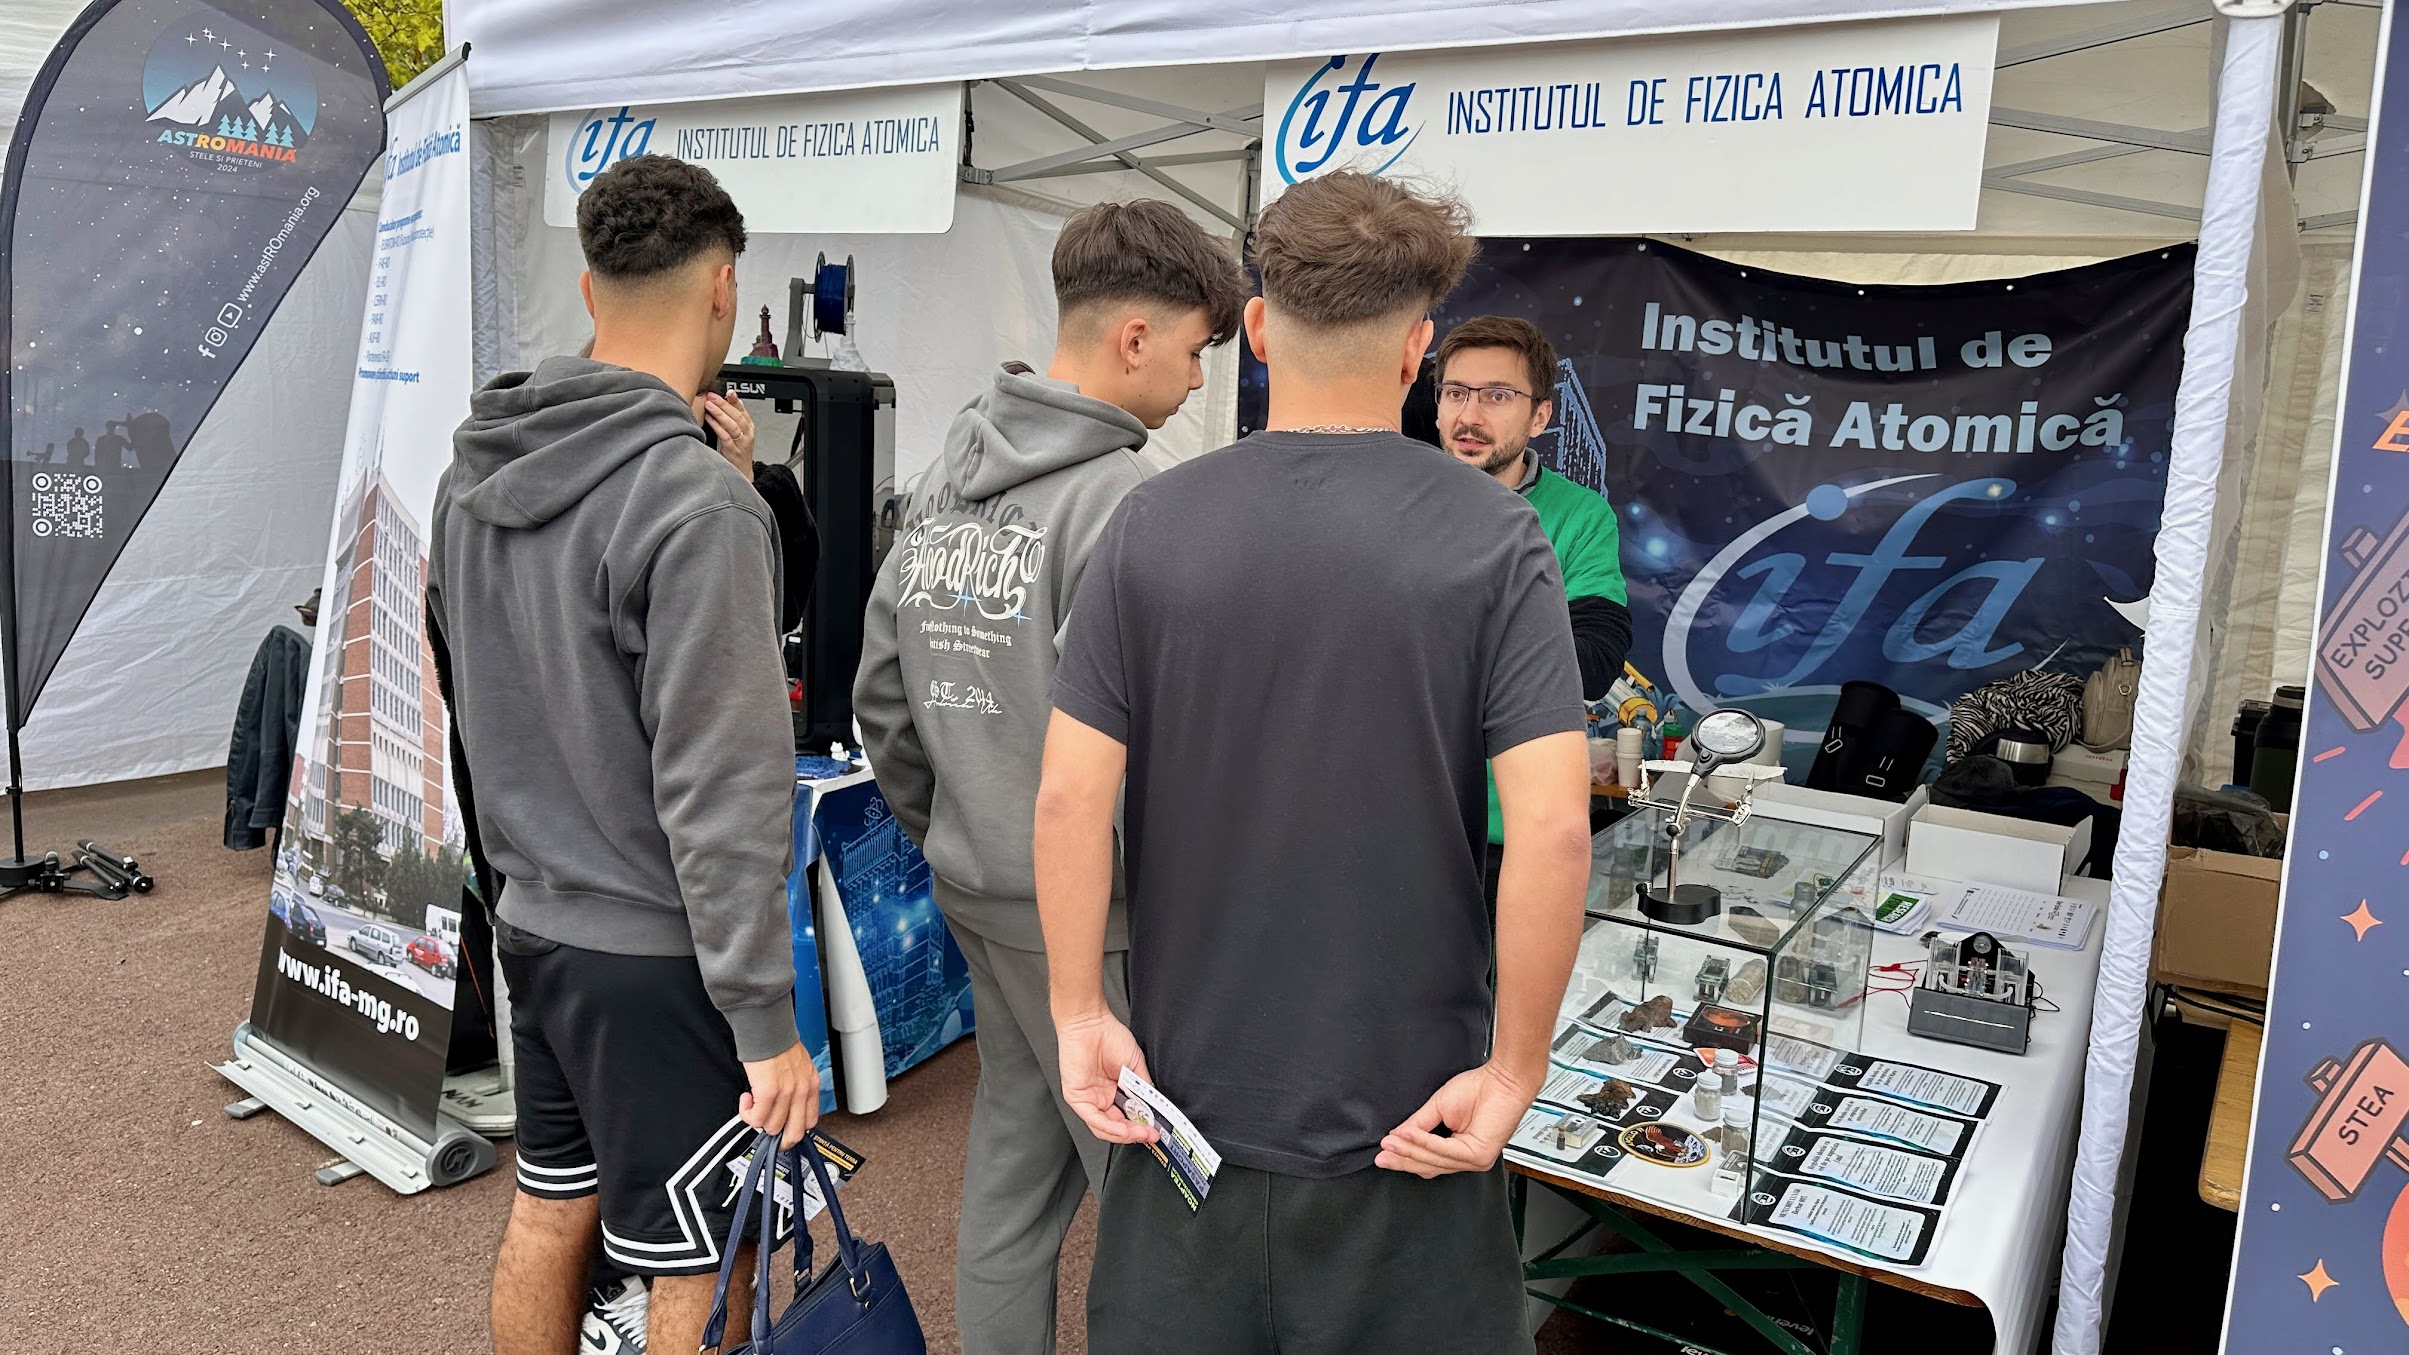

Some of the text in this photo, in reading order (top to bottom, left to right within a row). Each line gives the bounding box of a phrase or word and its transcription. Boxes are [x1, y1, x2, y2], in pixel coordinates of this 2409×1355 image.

[1447, 62, 1962, 134] INSTITUTUL DE FIZICA ATOMICA
[157, 129, 297, 163] ASTROMANIA
[189, 150, 214, 161] STELE
[225, 156, 263, 169] PRIETENI
[217, 164, 238, 173] 2024
[676, 116, 939, 160] INSTITUTUL DE FIZICA ATOMICA
[237, 186, 320, 302] www.astROmania.org
[1641, 302, 2052, 372] Institutul de
[1633, 384, 2125, 454] Fizică Atomică
[1714, 477, 2046, 696] ifa
[2330, 569, 2409, 669] EXPLOZ
[2338, 1084, 2395, 1147] STEA
